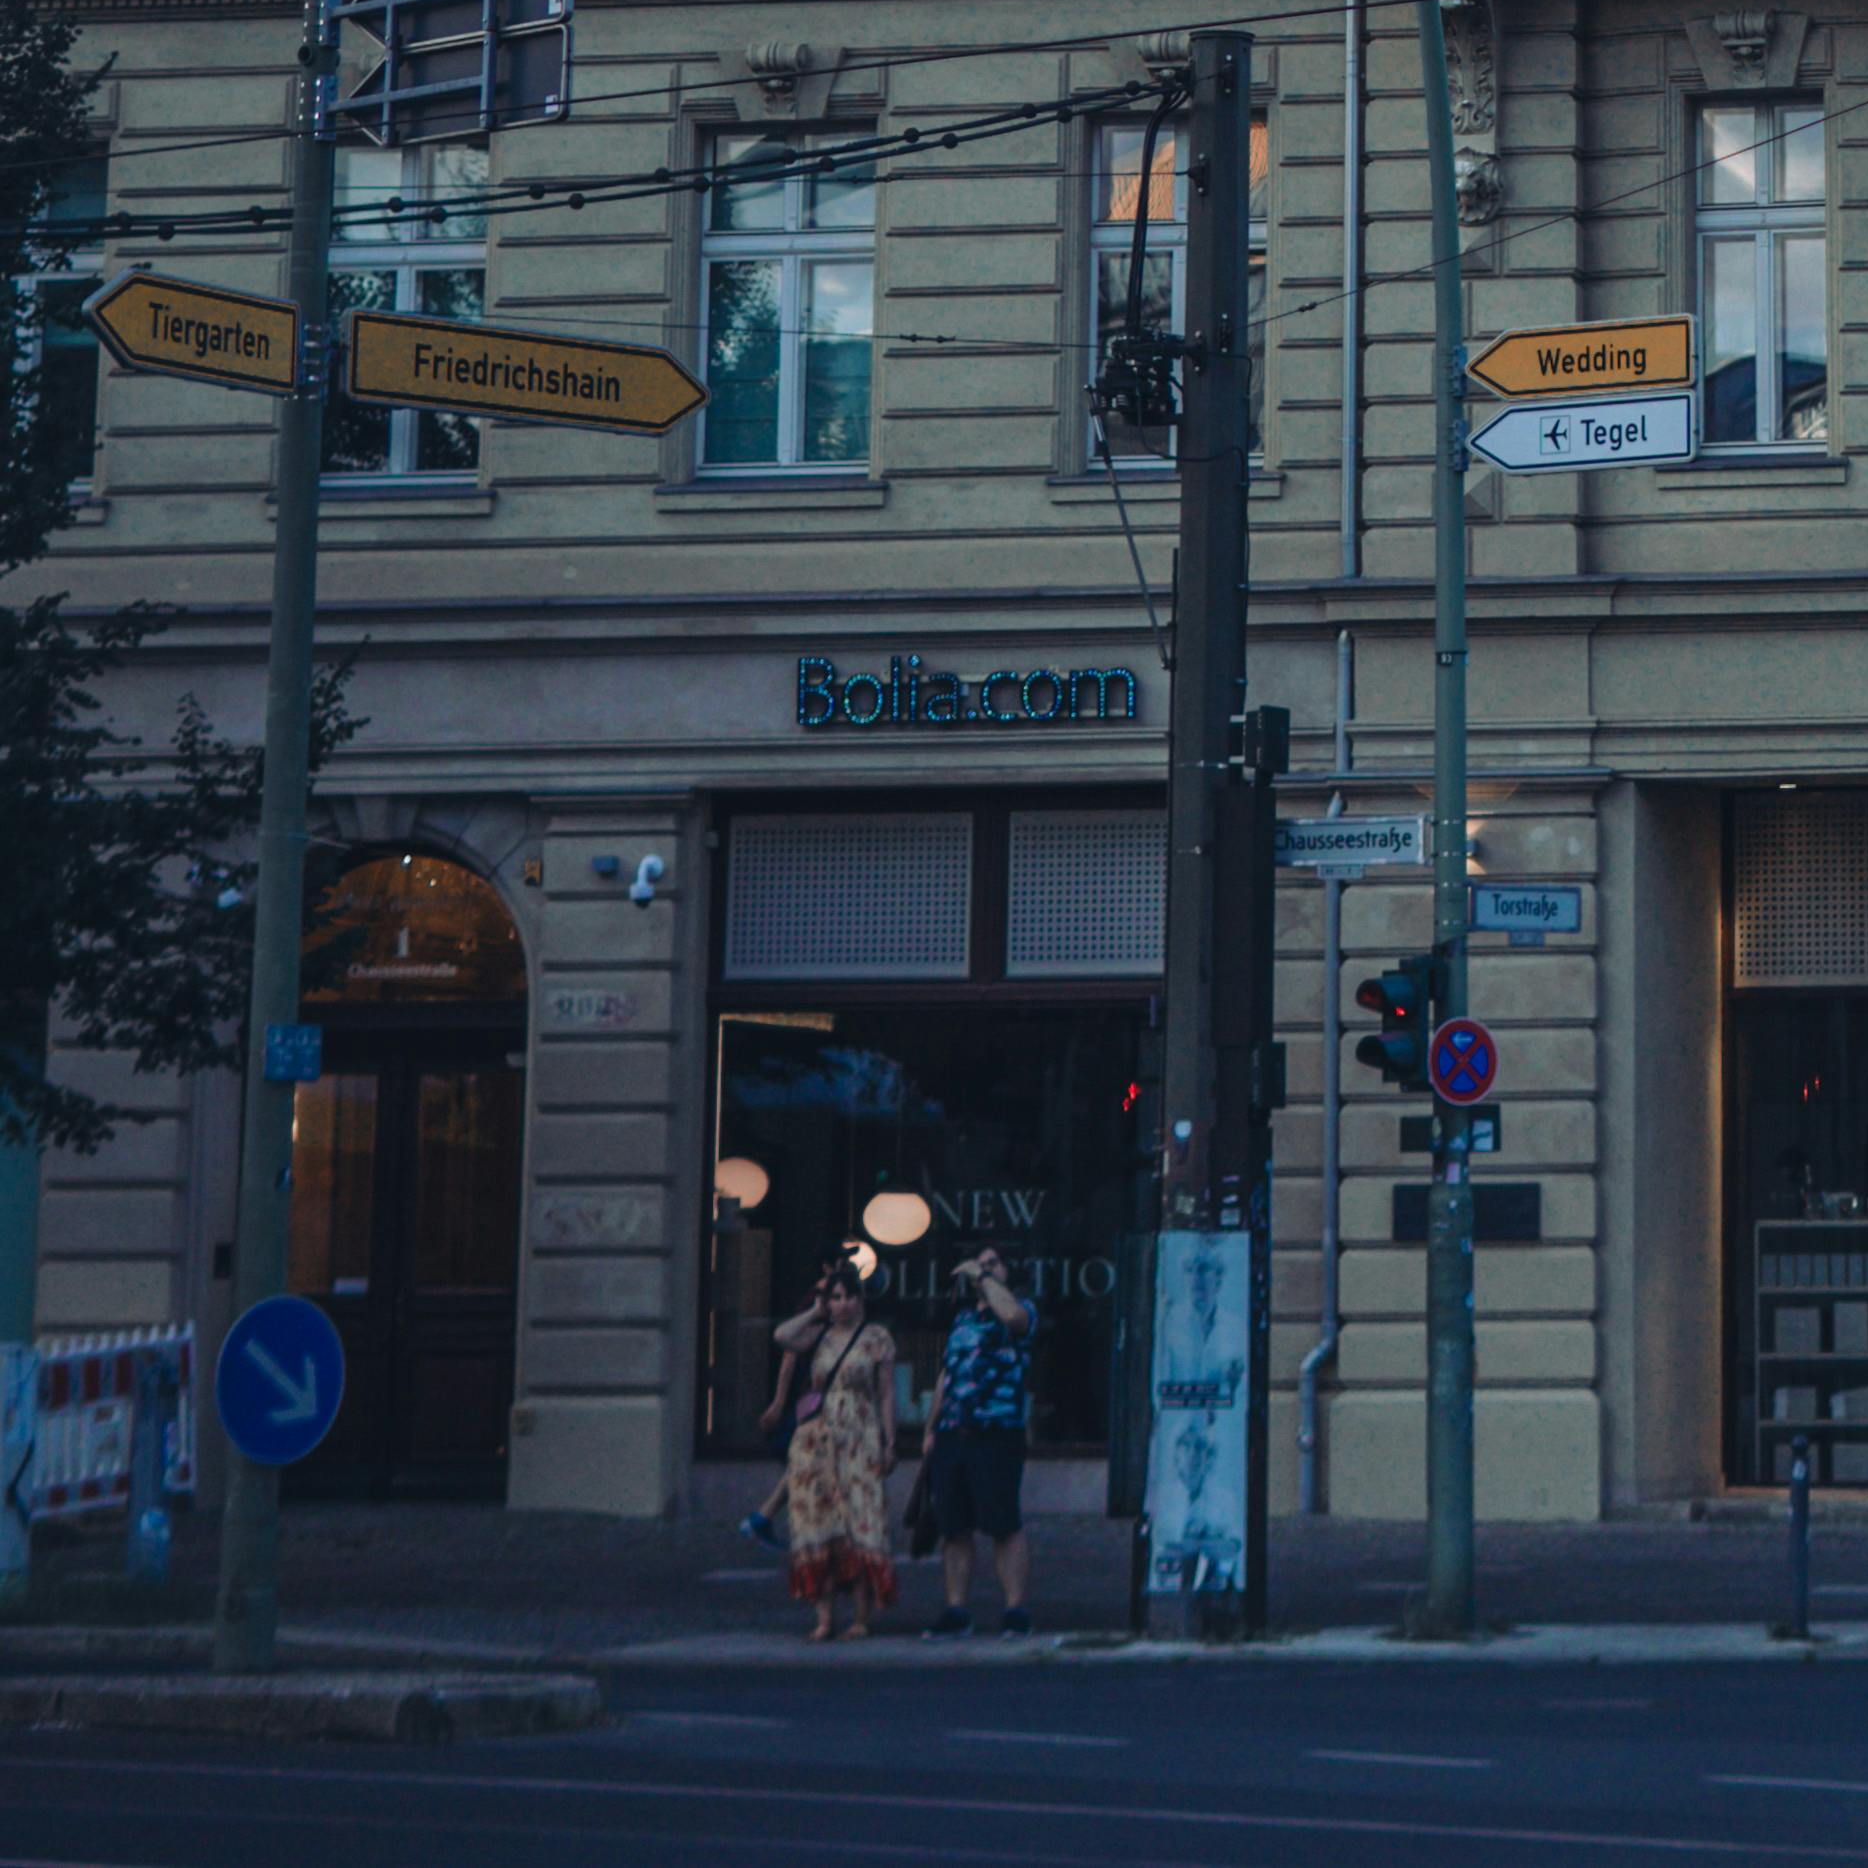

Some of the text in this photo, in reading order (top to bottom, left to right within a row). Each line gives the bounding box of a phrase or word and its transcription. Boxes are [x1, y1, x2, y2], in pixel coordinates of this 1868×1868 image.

[149, 301, 270, 360] Tiergarten
[414, 343, 621, 402] Friedrichshain
[1537, 344, 1647, 376] Wedding
[1580, 414, 1648, 451] Tegel
[797, 654, 1138, 726] Bolia.com
[1493, 893, 1558, 921] Torstraße
[931, 1189, 1047, 1230] NEW
